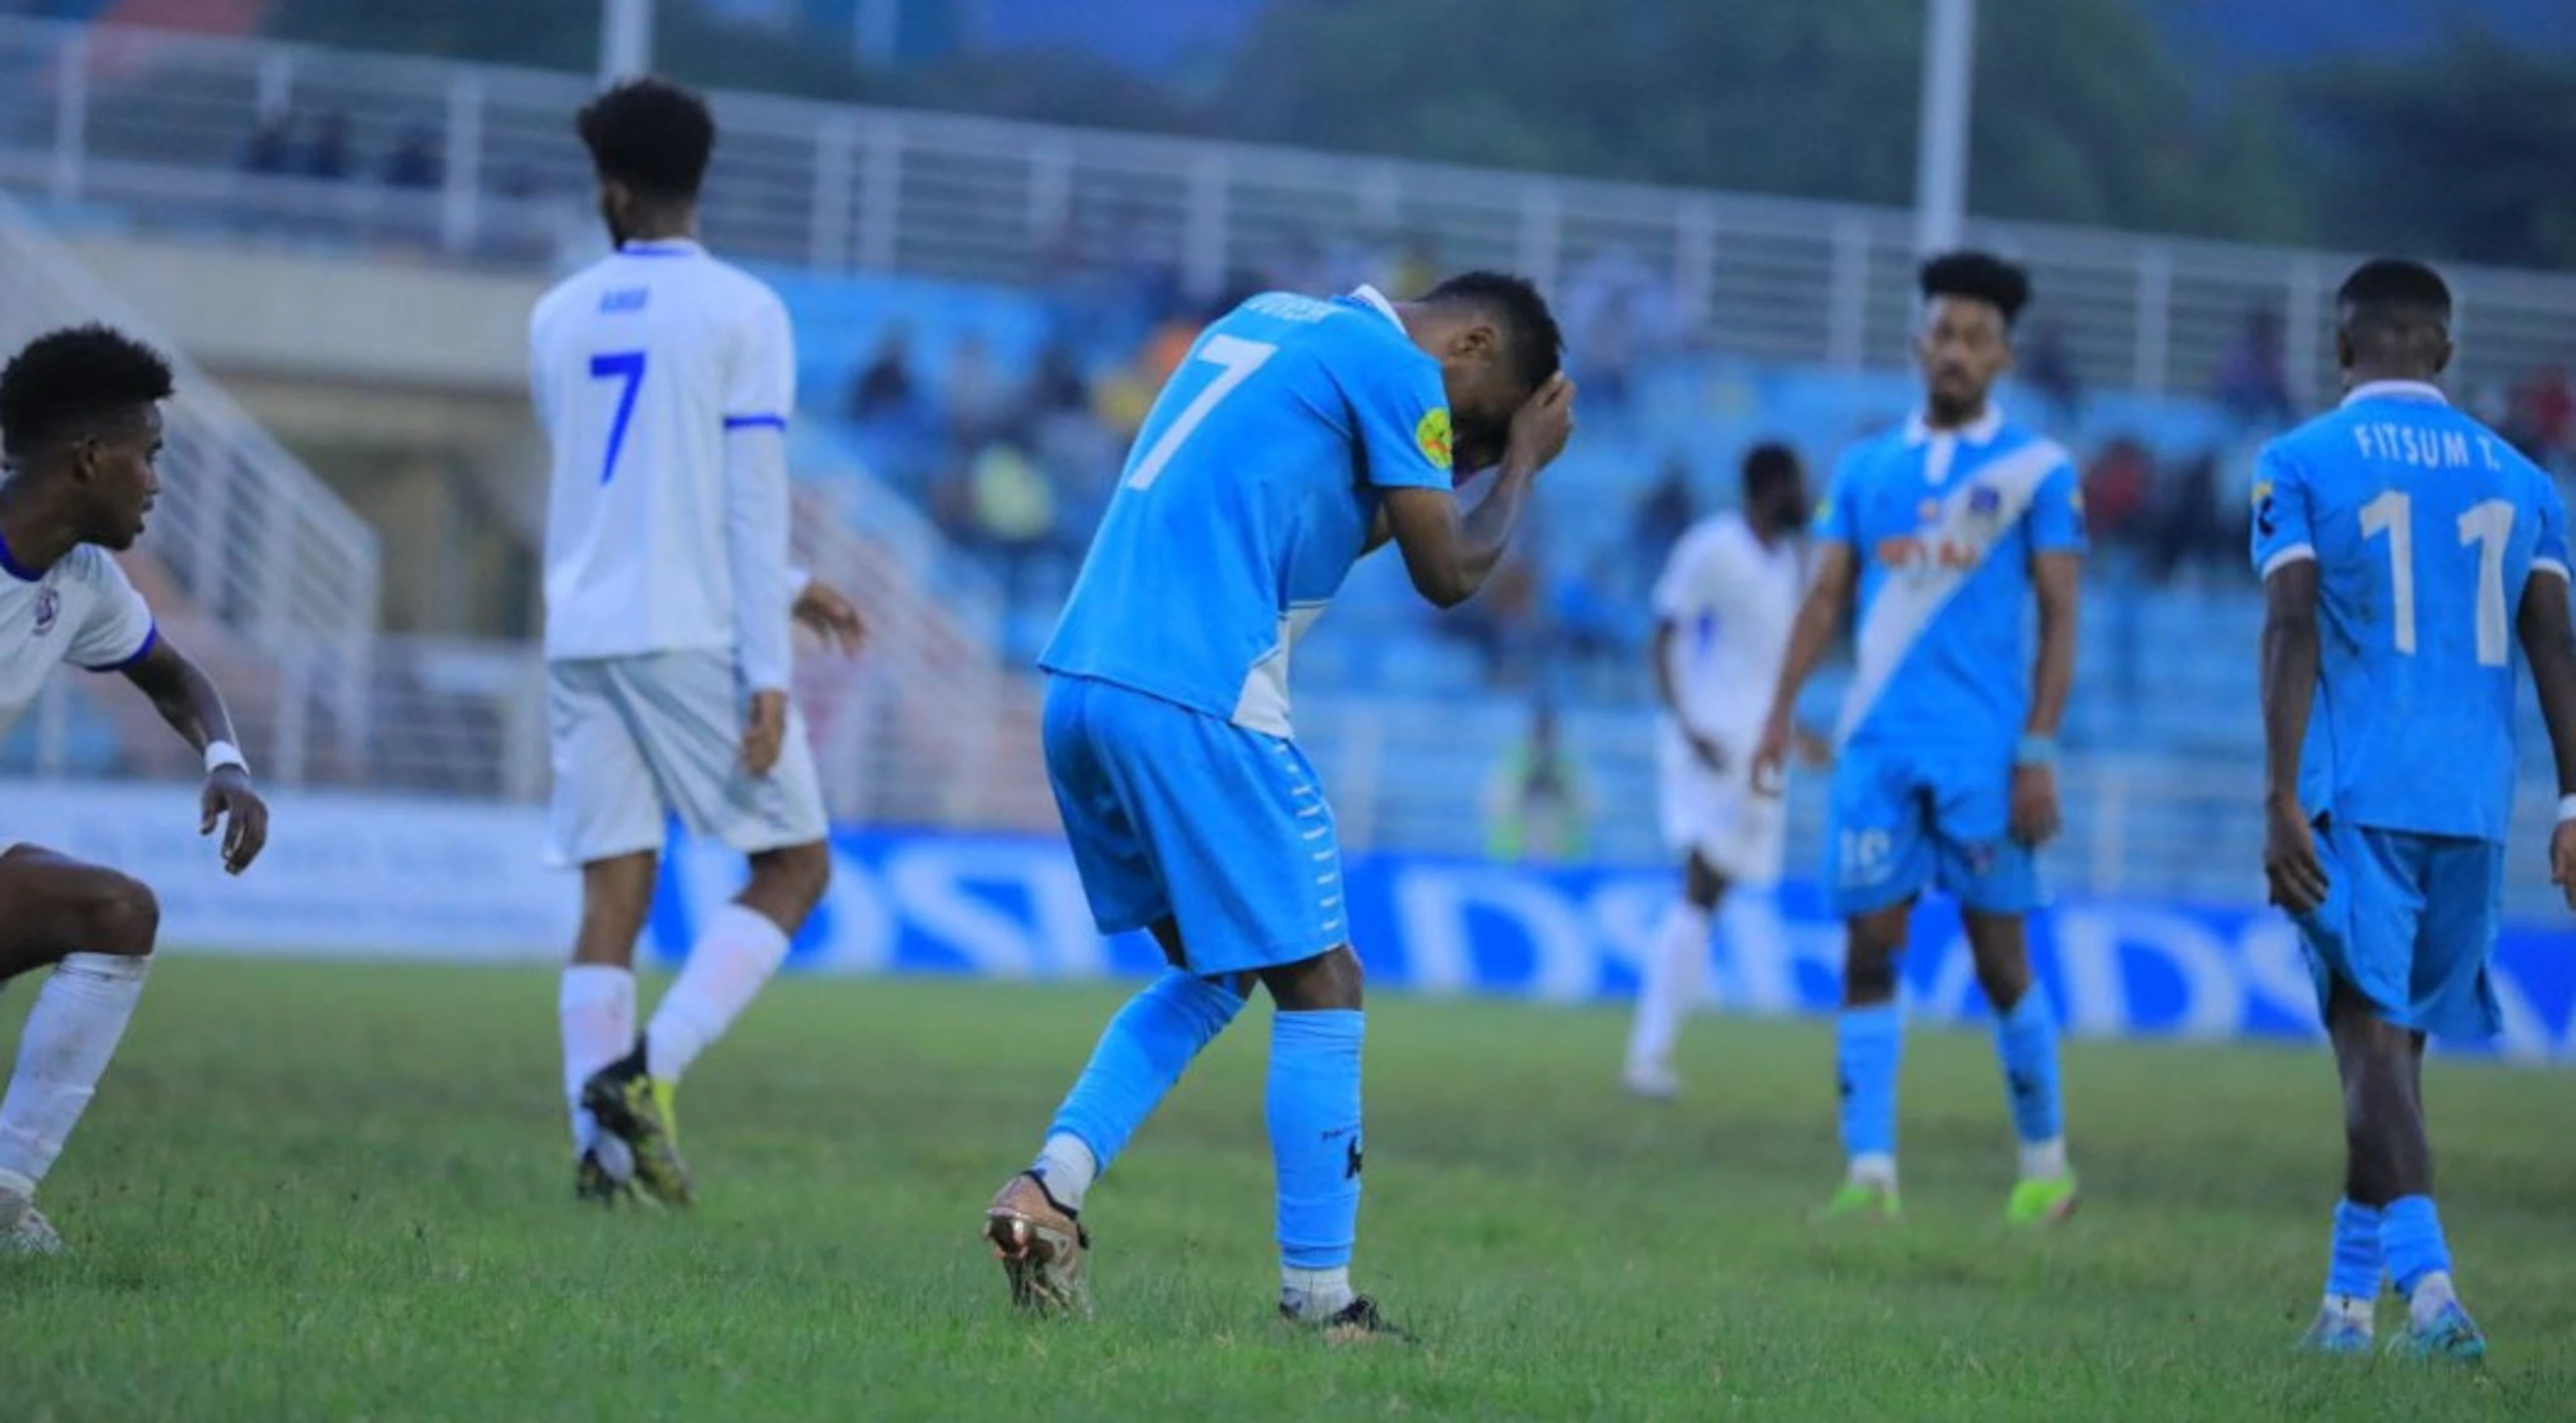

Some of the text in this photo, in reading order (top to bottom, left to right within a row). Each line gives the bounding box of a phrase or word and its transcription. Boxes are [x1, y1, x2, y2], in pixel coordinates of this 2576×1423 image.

[589, 350, 648, 486] 7
[1127, 333, 1277, 492] 7
[2353, 421, 2471, 470] FITSUM
[2358, 489, 2516, 668] 11
